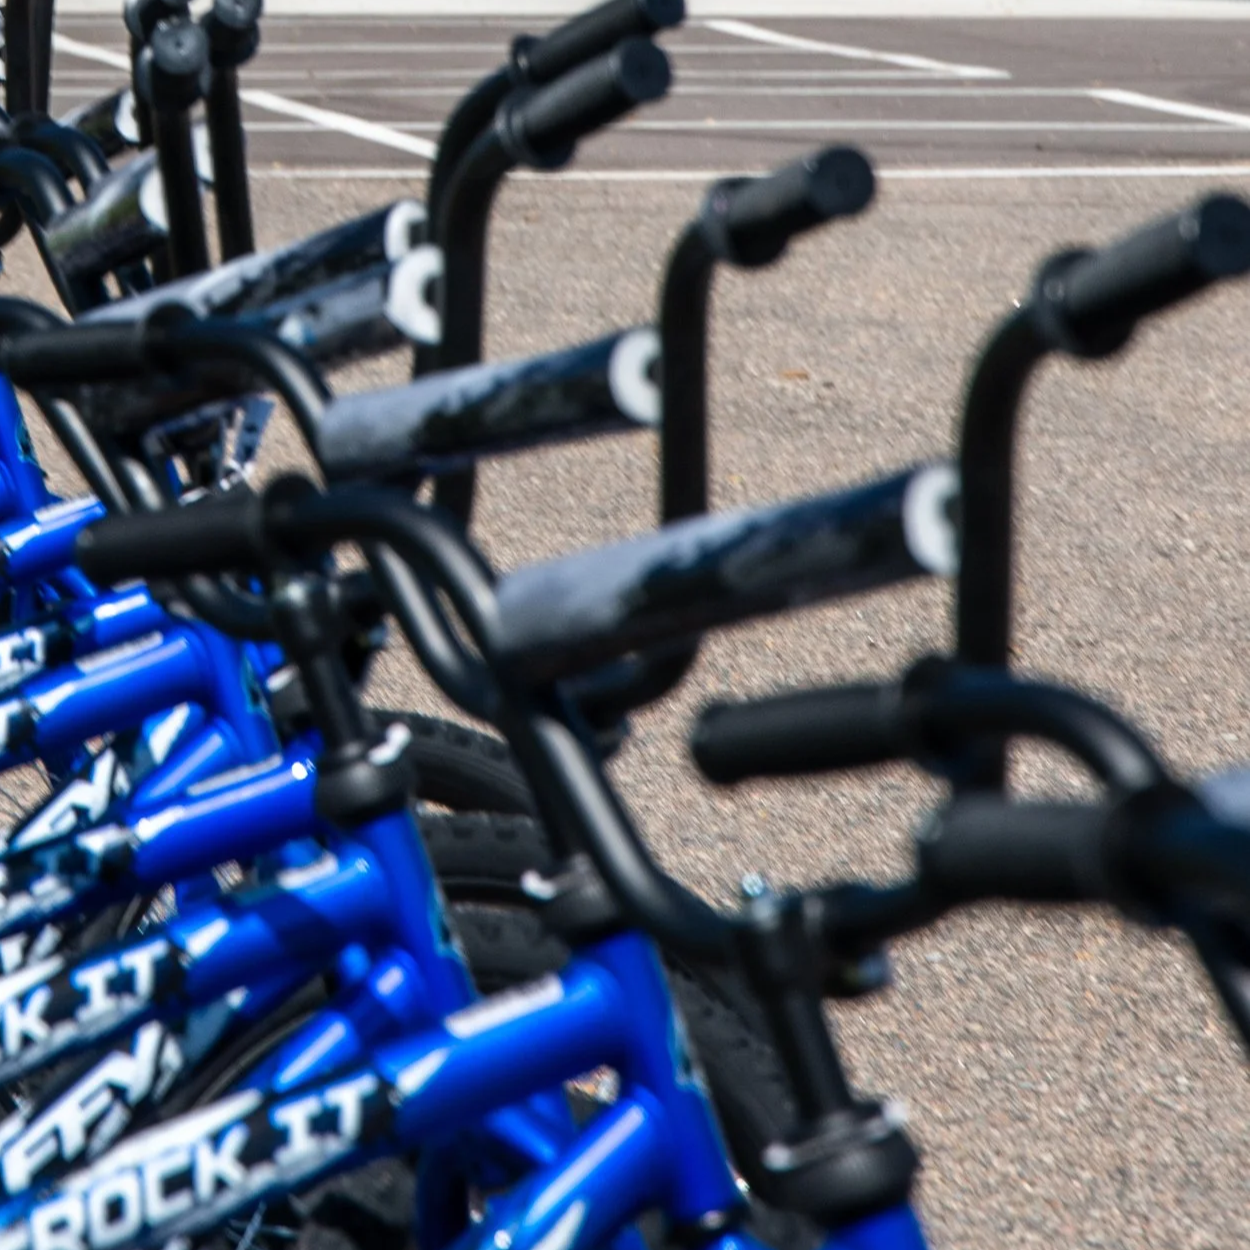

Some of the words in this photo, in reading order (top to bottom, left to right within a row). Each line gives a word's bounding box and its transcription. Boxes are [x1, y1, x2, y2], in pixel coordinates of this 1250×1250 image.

[71, 938, 169, 1021] IT
[29, 1122, 249, 1250] ROCK
[270, 1072, 379, 1164] IT
